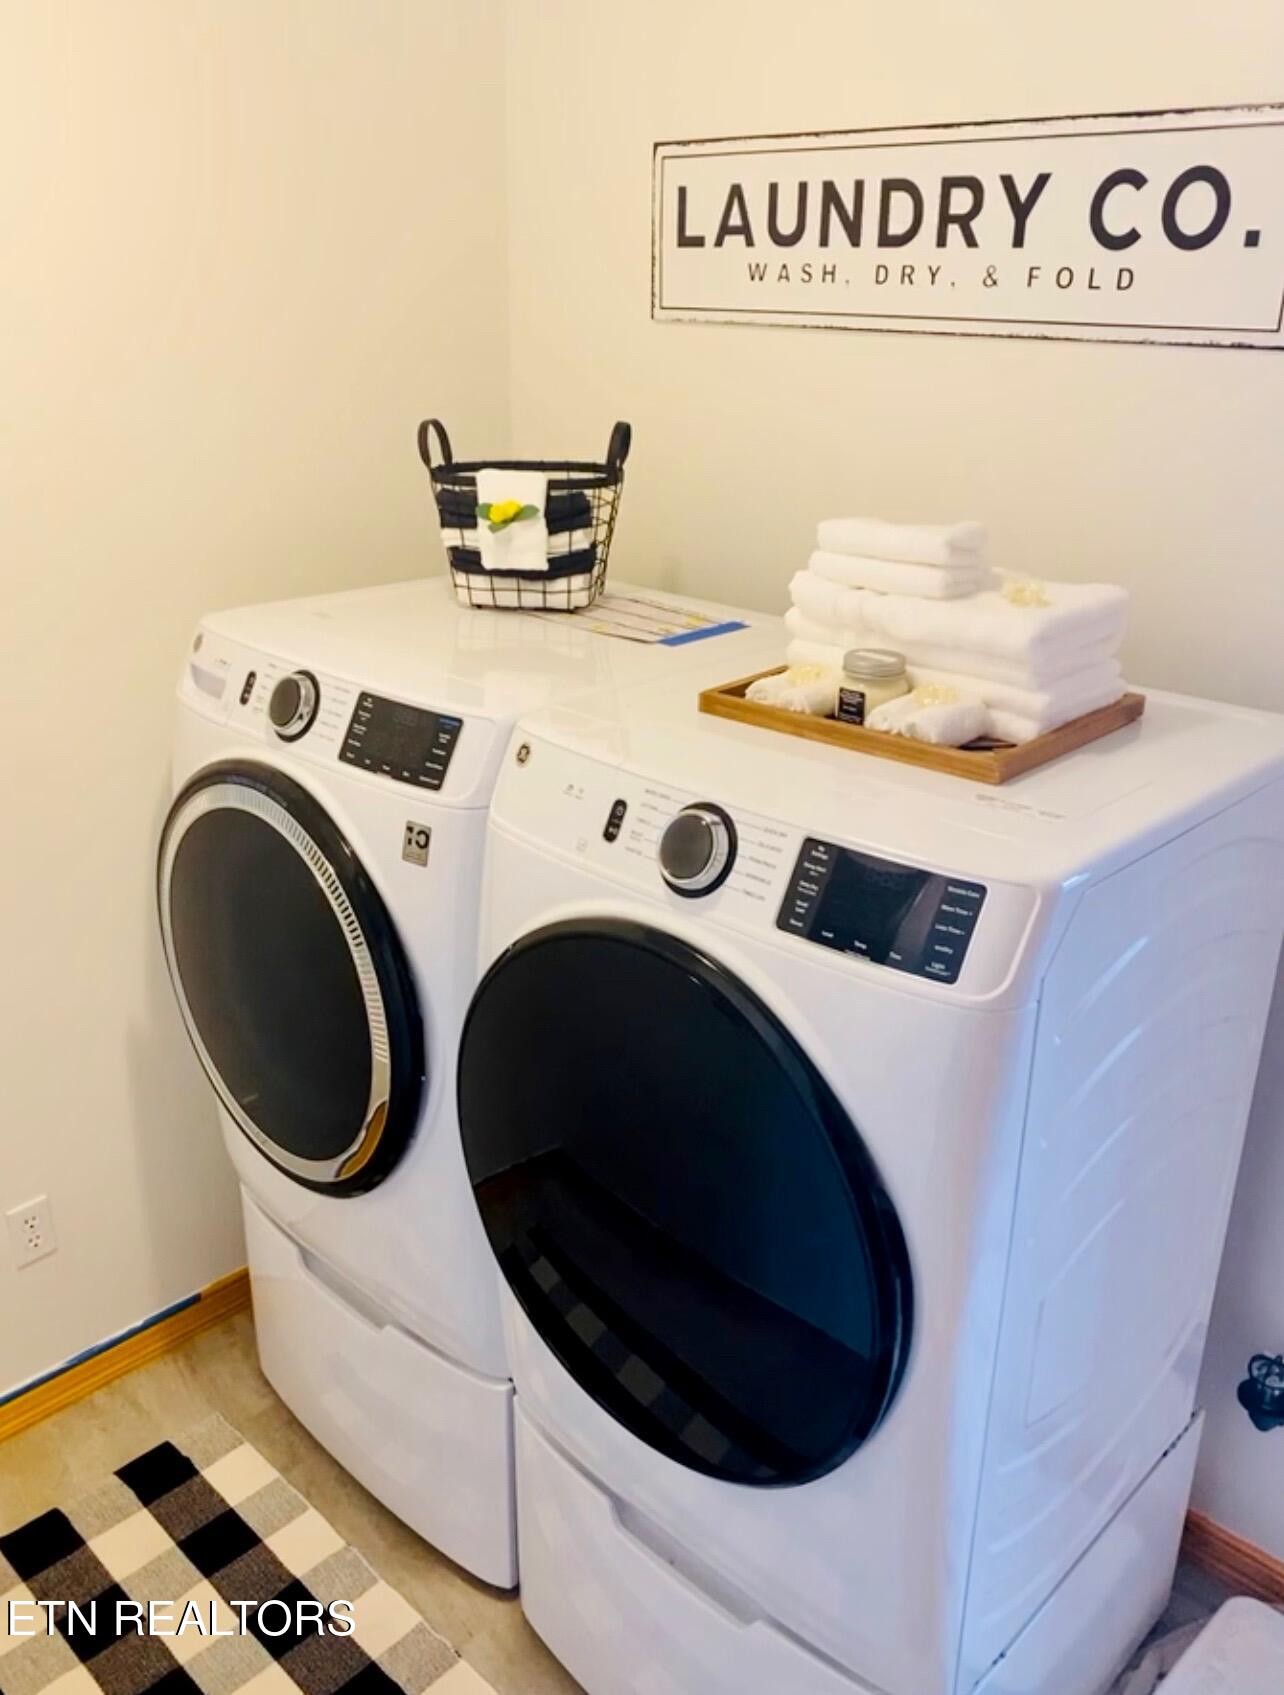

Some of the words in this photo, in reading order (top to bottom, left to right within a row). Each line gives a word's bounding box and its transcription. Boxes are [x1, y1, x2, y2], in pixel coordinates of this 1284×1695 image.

[677, 172, 1052, 249] LAUNDRY
[1089, 165, 1261, 251] CO.
[875, 264, 956, 290] DRY,
[982, 264, 999, 289] &
[1026, 266, 1136, 292] FOLD
